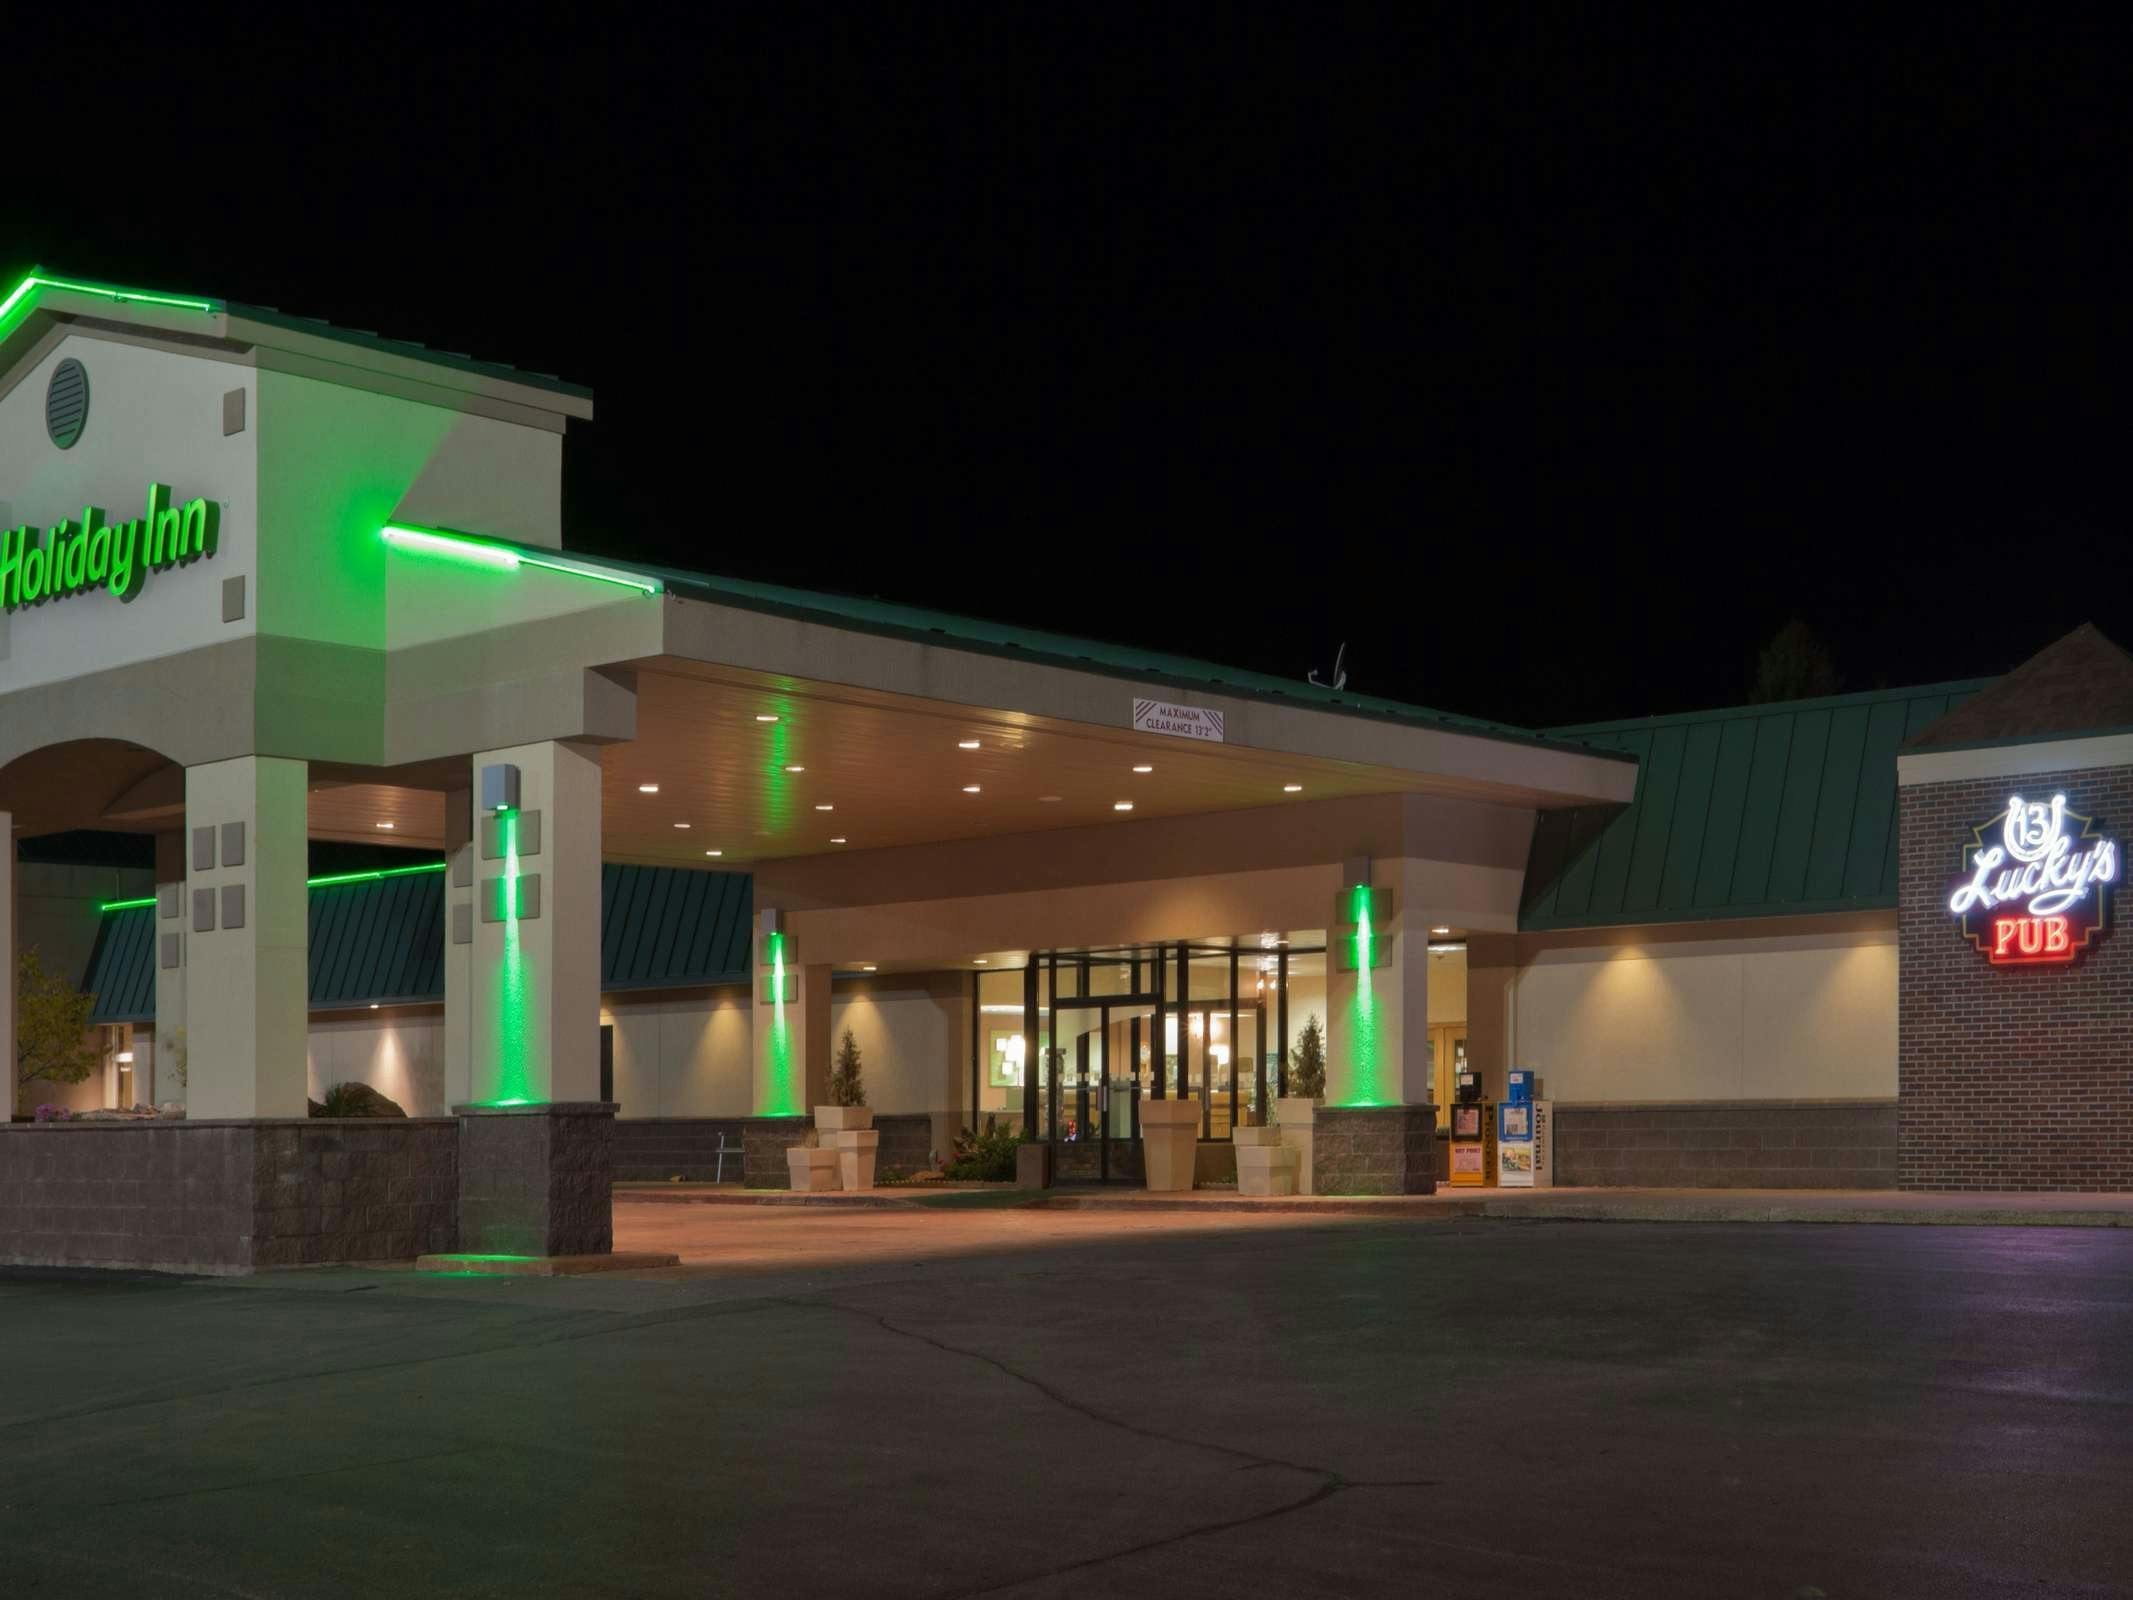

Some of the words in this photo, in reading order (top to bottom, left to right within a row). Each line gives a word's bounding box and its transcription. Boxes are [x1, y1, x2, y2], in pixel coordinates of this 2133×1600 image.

[0, 503, 144, 602] Holiday
[142, 482, 210, 568] Inn
[1146, 718, 1192, 734] CLEARANCE
[1160, 706, 1200, 720] MAXIMUM
[2014, 804, 2050, 846] 13
[1950, 836, 2116, 915] Lucky's
[1995, 918, 2070, 954] PUB
[1534, 1103, 1544, 1171] Journal
